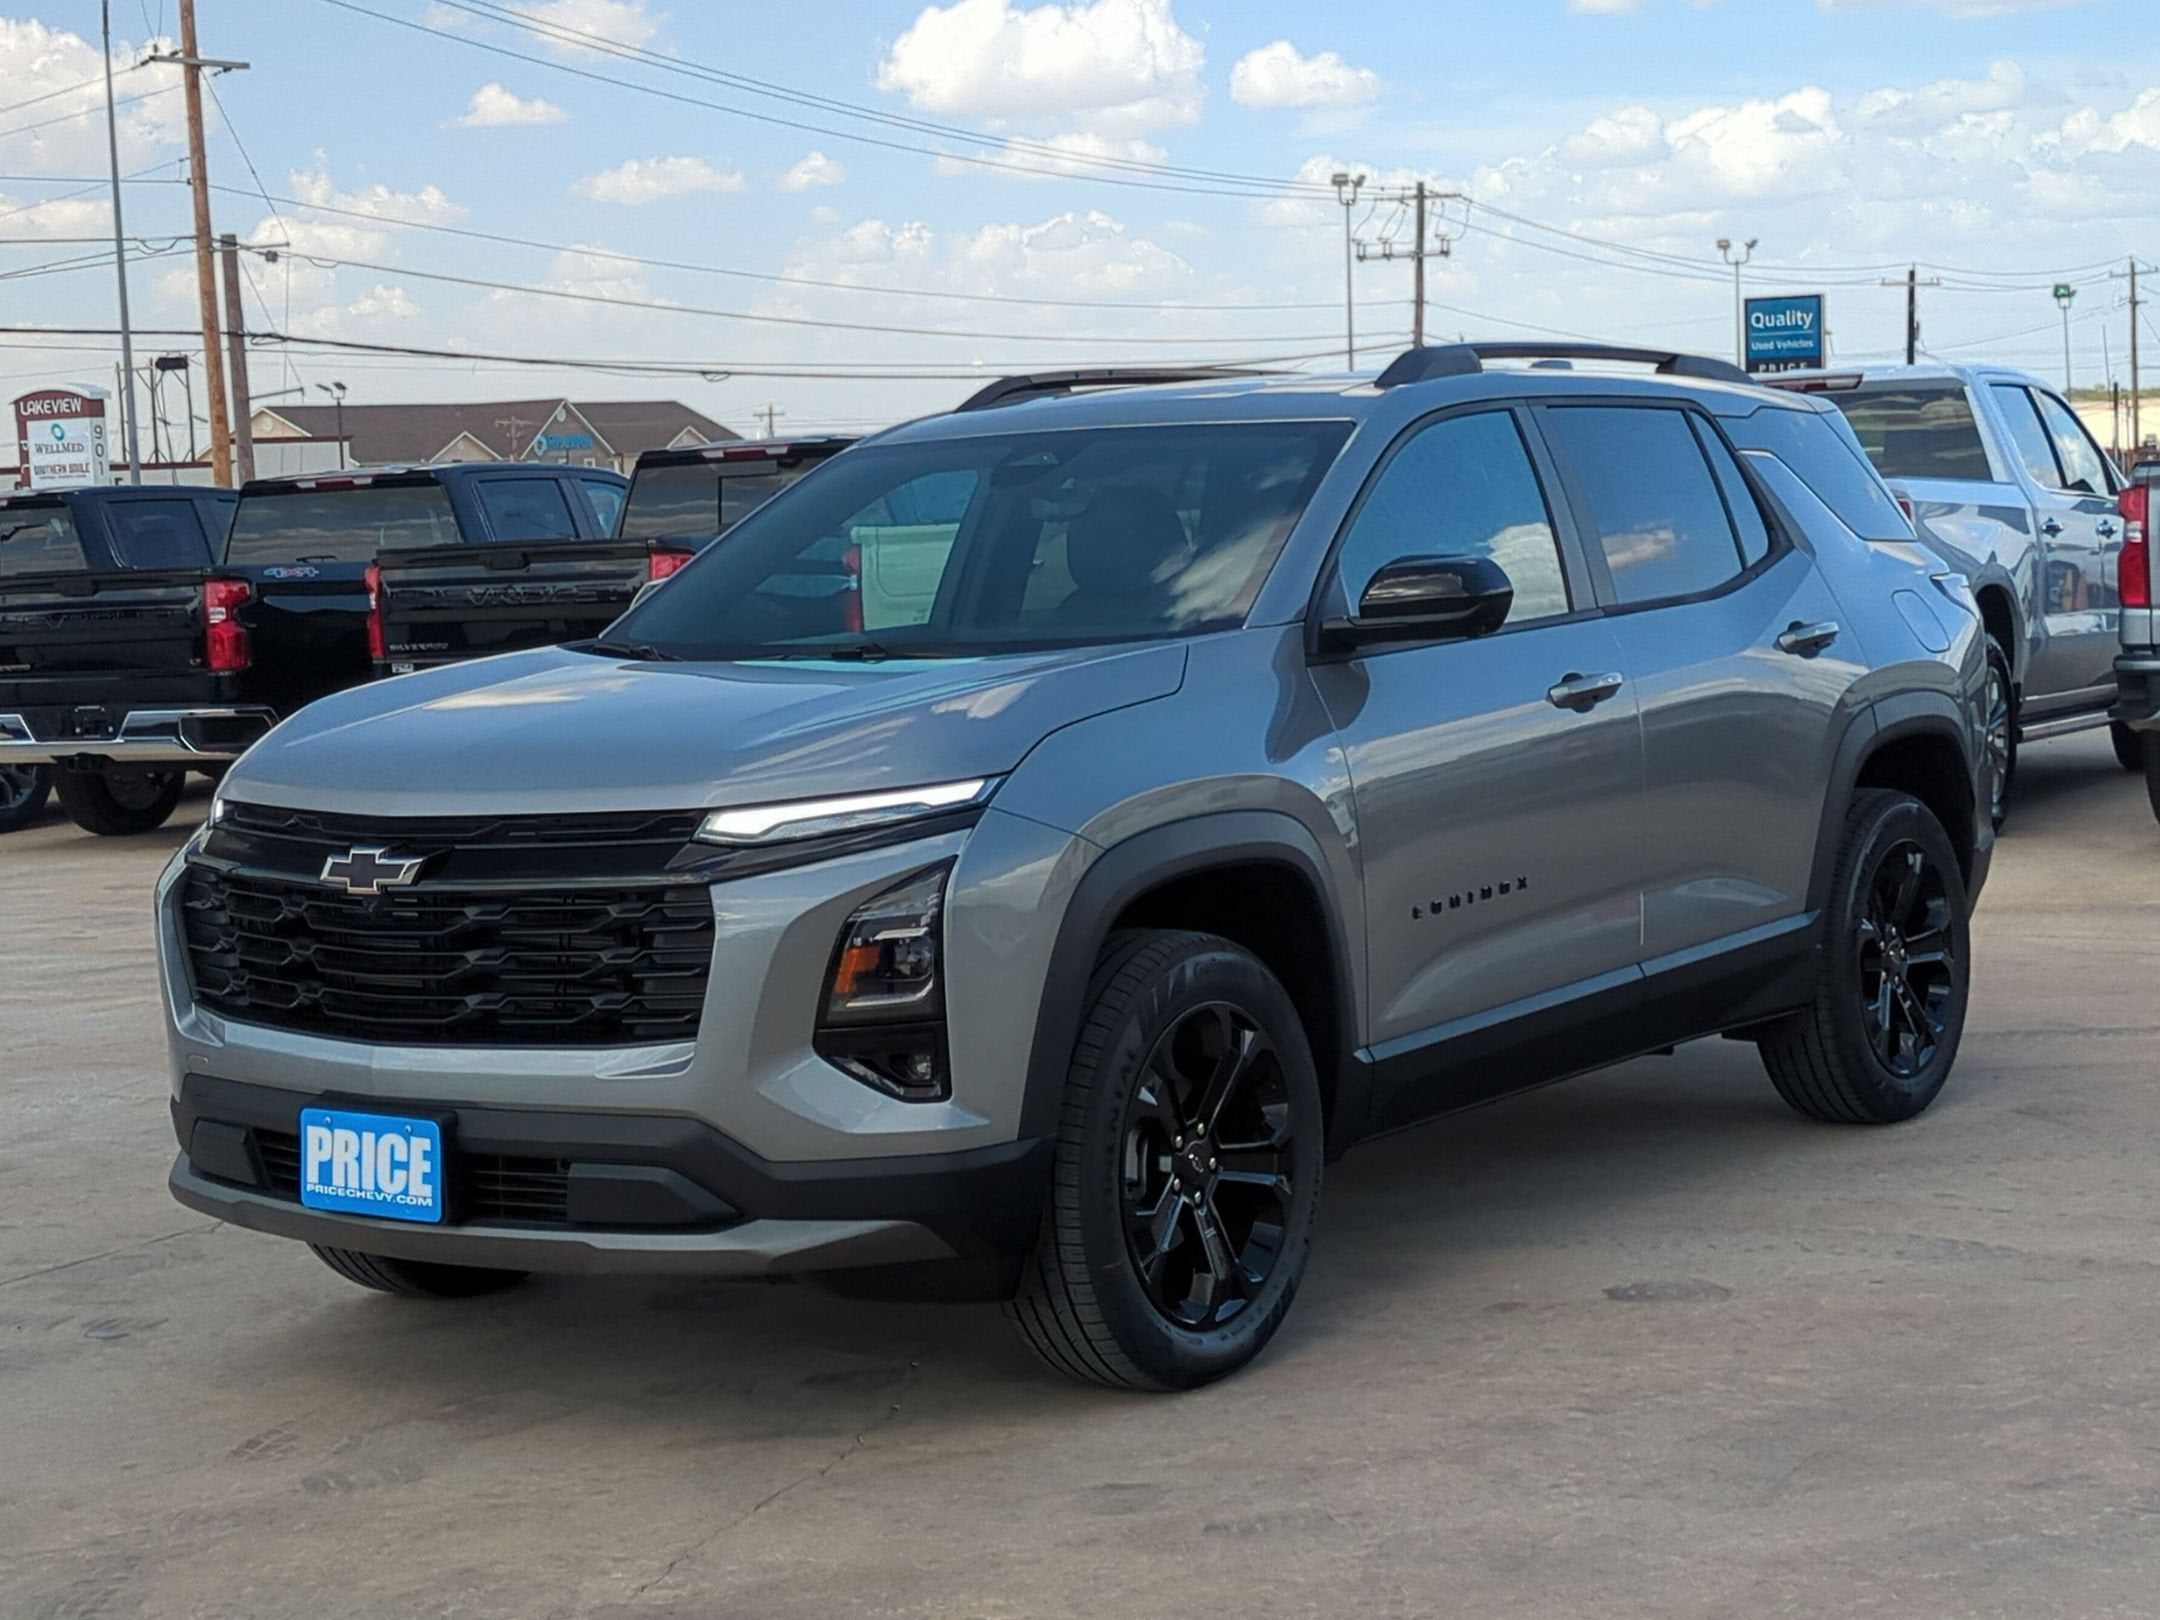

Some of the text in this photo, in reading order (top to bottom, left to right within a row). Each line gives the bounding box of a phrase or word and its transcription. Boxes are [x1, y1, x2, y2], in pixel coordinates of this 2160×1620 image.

[1750, 310, 1813, 329] Quality
[1751, 340, 1814, 350] Used Vehicles
[20, 398, 82, 415] LAKEVIEW
[1412, 876, 1528, 920] EQUINOX
[306, 1125, 433, 1197] PRICE
[306, 1183, 433, 1207] PRICECHEVY.COM
